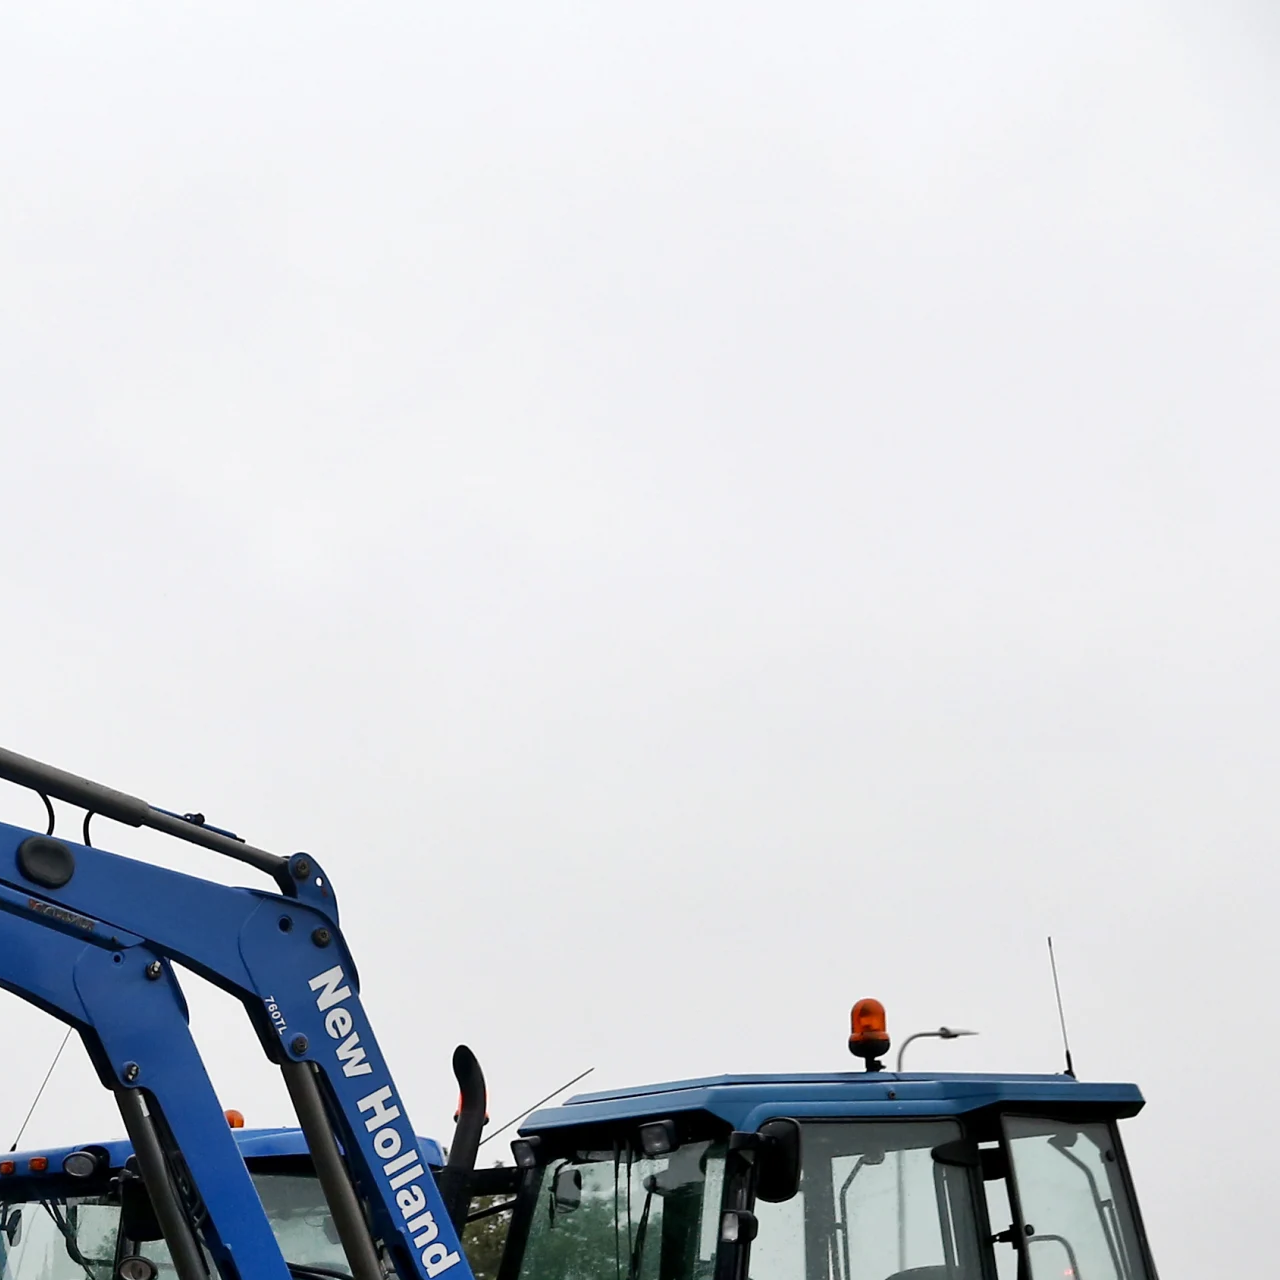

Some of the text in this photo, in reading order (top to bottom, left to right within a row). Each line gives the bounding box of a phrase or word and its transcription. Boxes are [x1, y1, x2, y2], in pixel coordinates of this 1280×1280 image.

[265, 995, 287, 1035] 760TL
[308, 964, 461, 1279] New Holland
